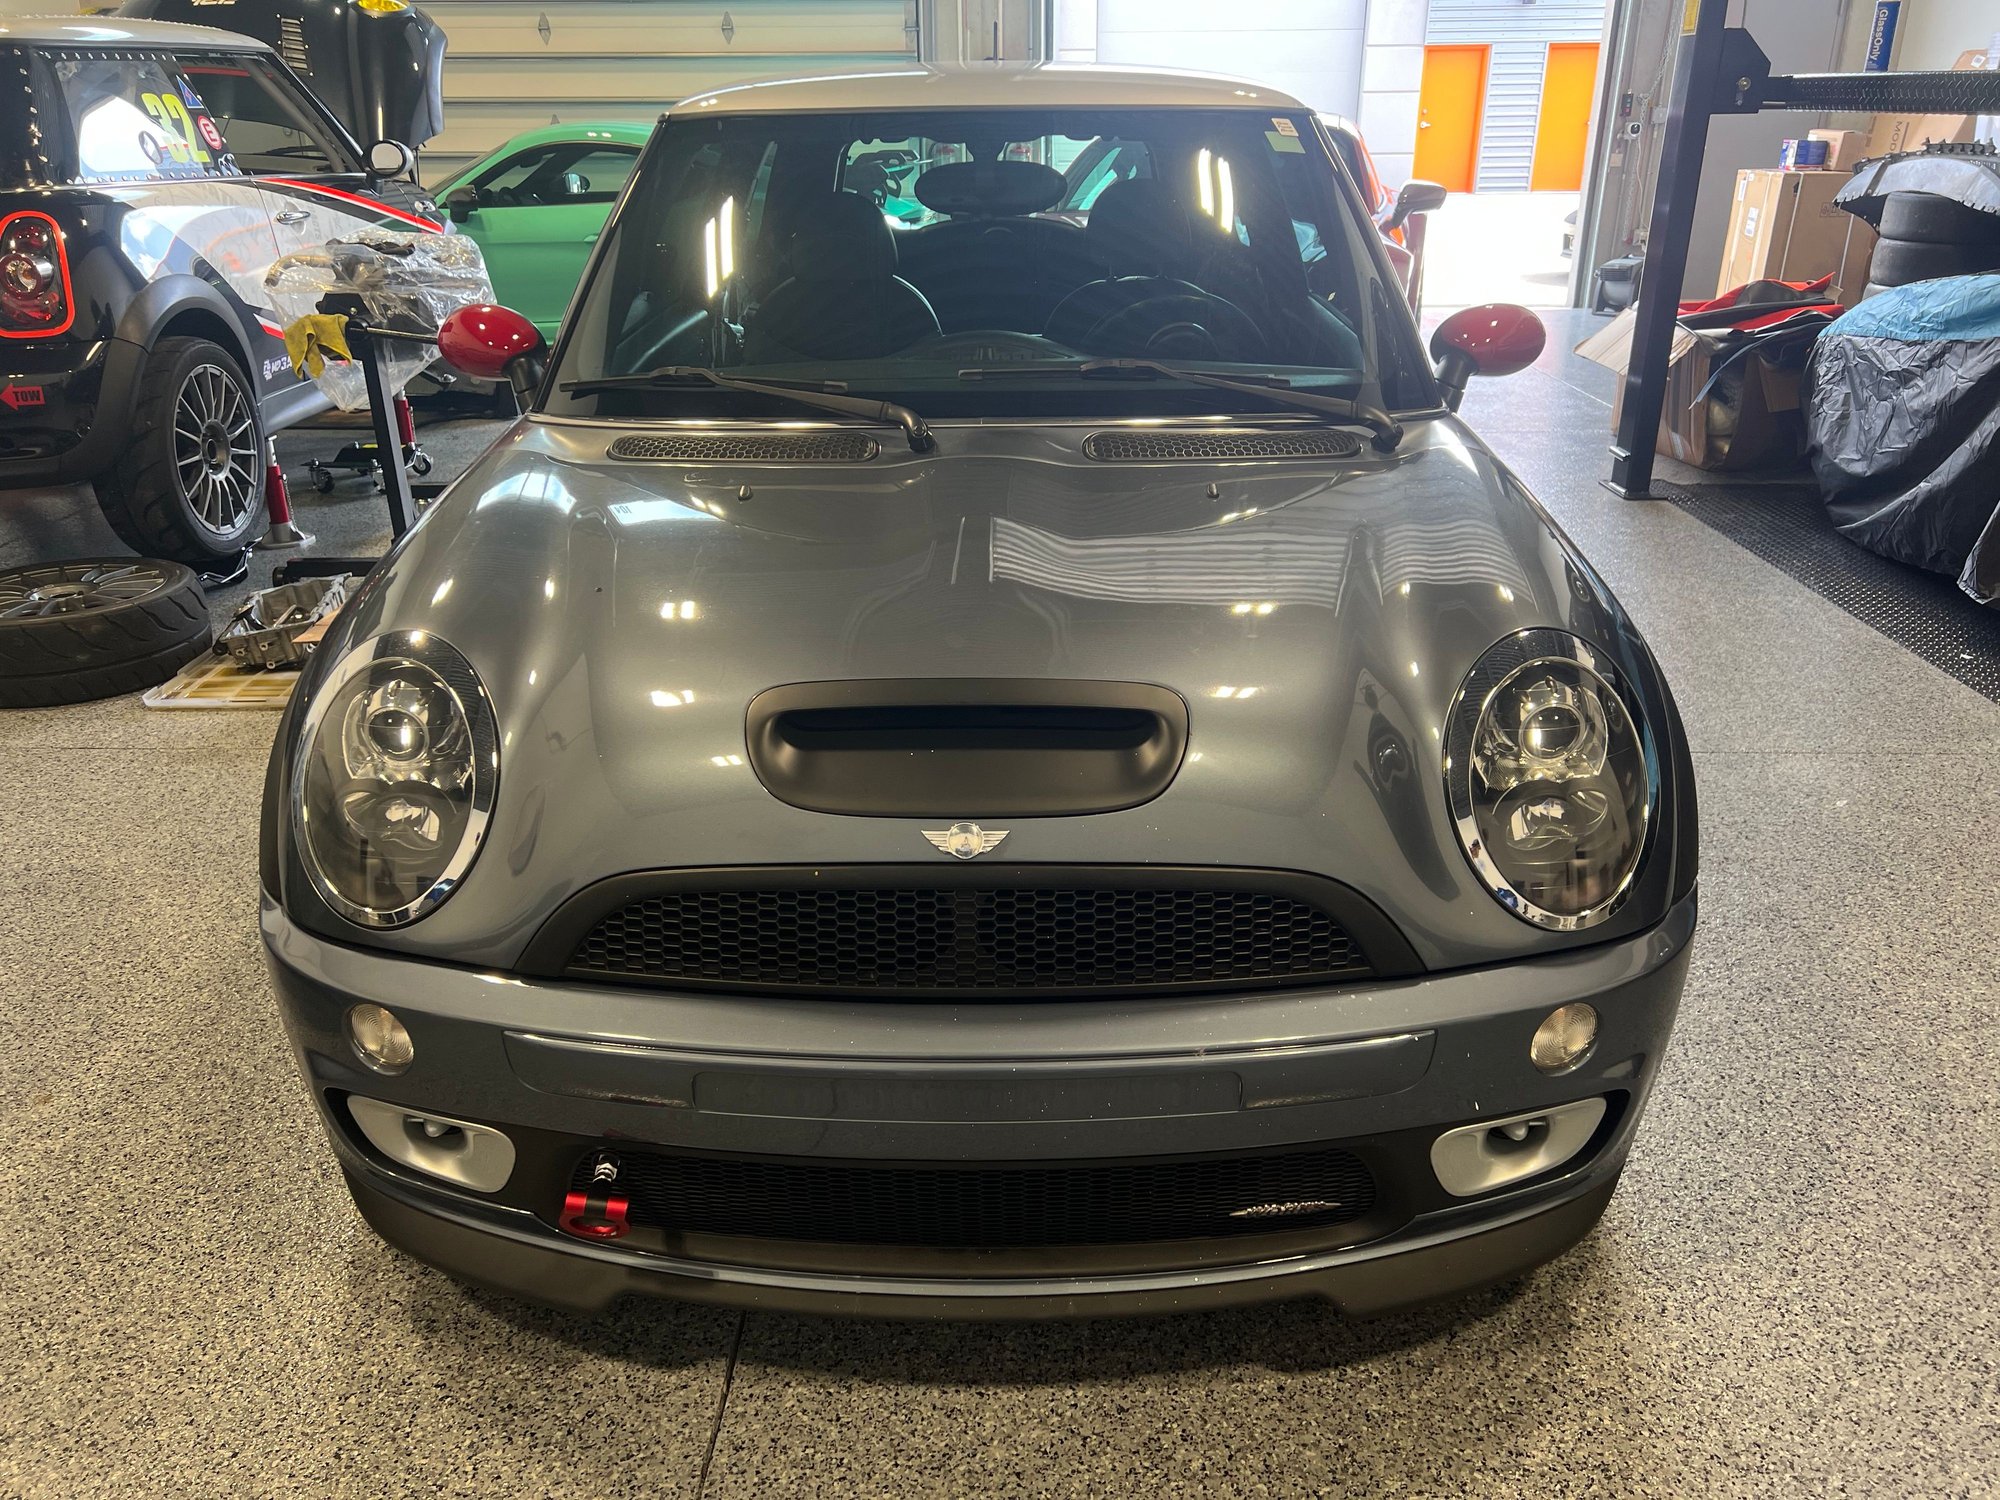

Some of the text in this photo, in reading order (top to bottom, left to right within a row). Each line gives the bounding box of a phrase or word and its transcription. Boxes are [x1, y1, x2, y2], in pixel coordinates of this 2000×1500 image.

[1870, 9, 1889, 61] GlassOnly
[141, 92, 211, 163] 32
[12, 390, 41, 402] TOW
